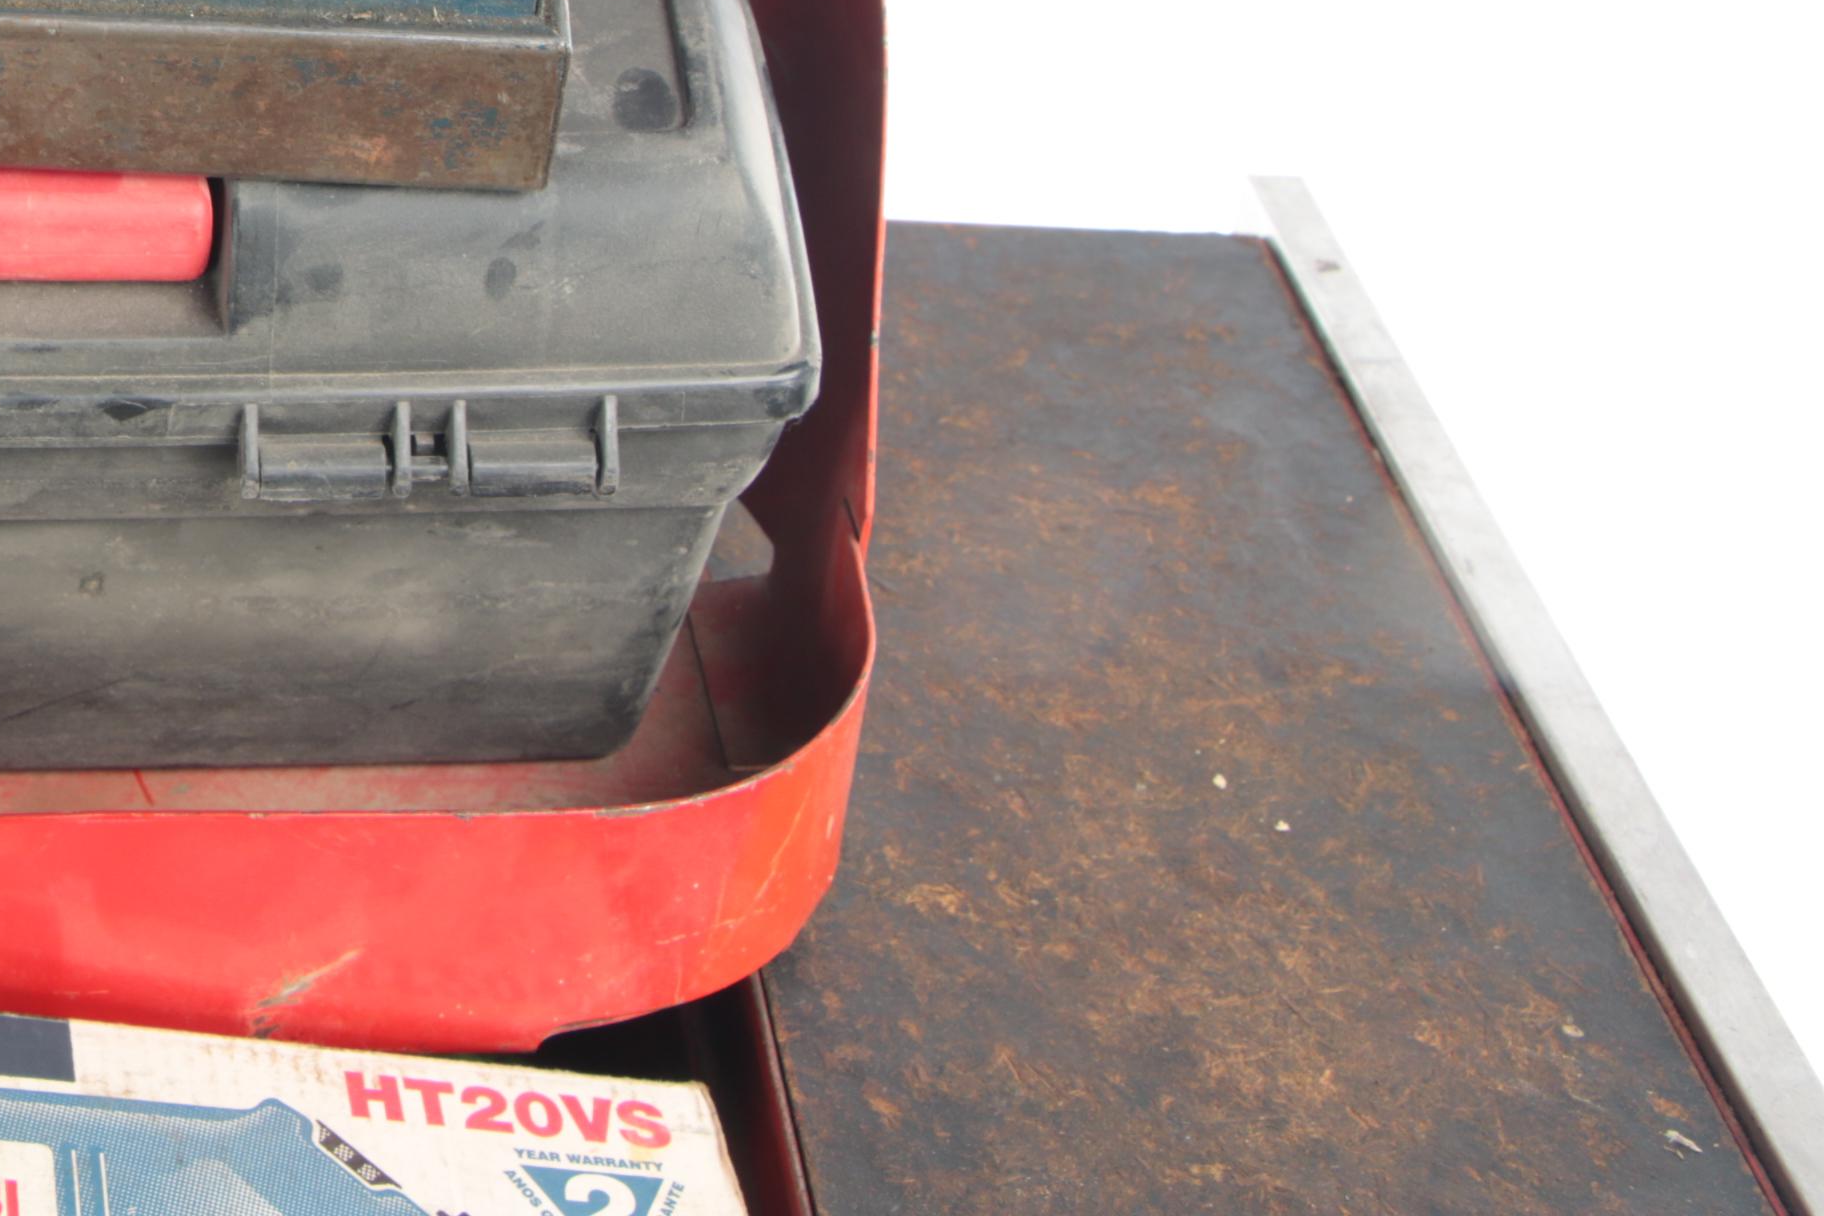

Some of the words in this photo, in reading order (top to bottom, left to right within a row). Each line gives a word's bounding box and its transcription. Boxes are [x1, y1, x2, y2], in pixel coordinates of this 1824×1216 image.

[345, 1071, 673, 1150] HT20VS
[513, 1147, 561, 1163] YEAR
[565, 1152, 664, 1173] WARRANTY
